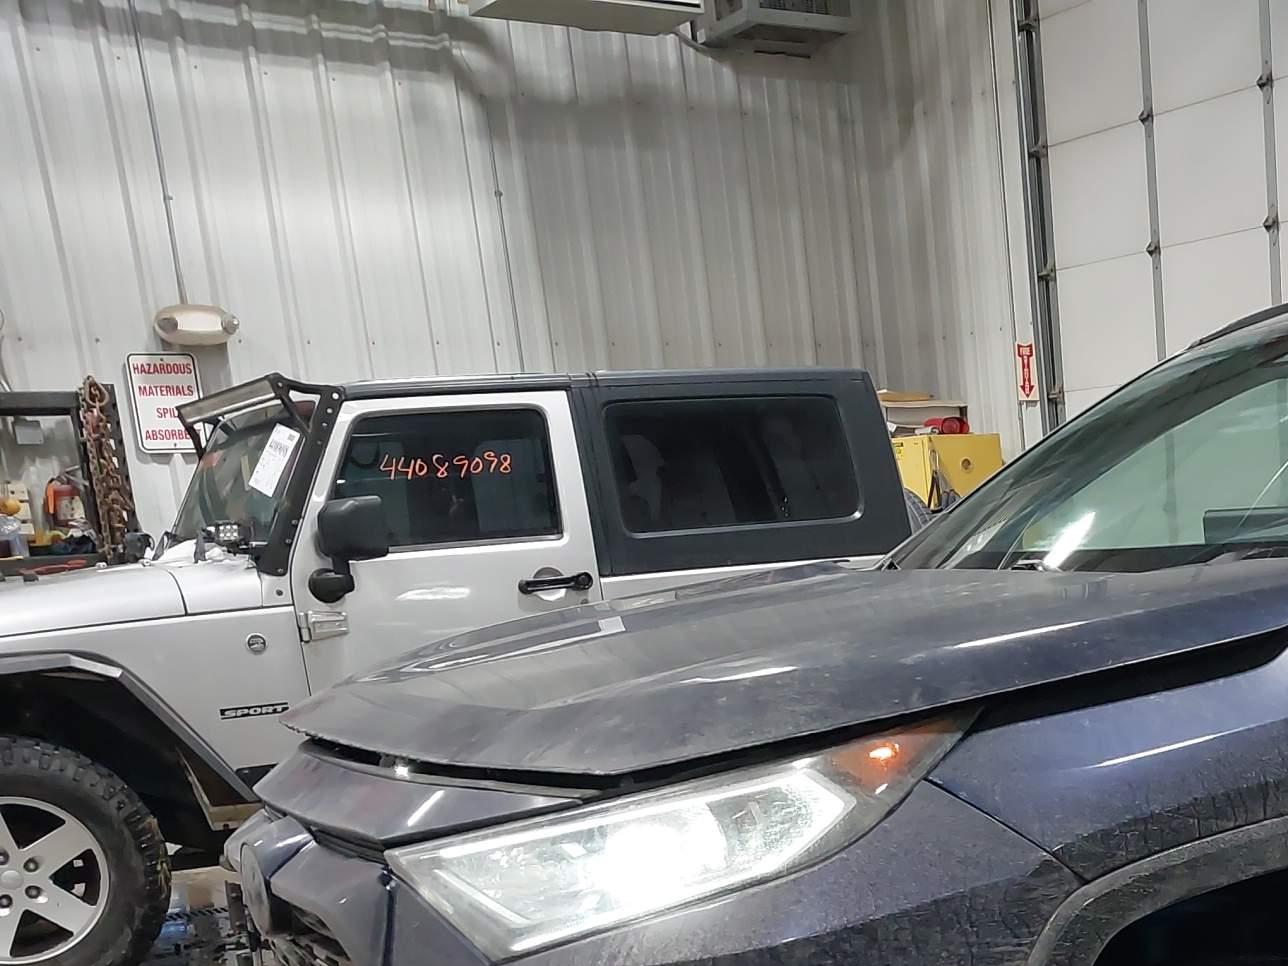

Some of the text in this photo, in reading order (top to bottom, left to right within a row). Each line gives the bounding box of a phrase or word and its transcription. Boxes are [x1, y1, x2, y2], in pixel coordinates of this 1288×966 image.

[132, 363, 193, 375] HAZARDOUS
[138, 385, 194, 397] MATERIALS
[156, 407, 179, 418] SPIL
[379, 451, 512, 481] 44089098
[223, 704, 285, 718] SPORT
